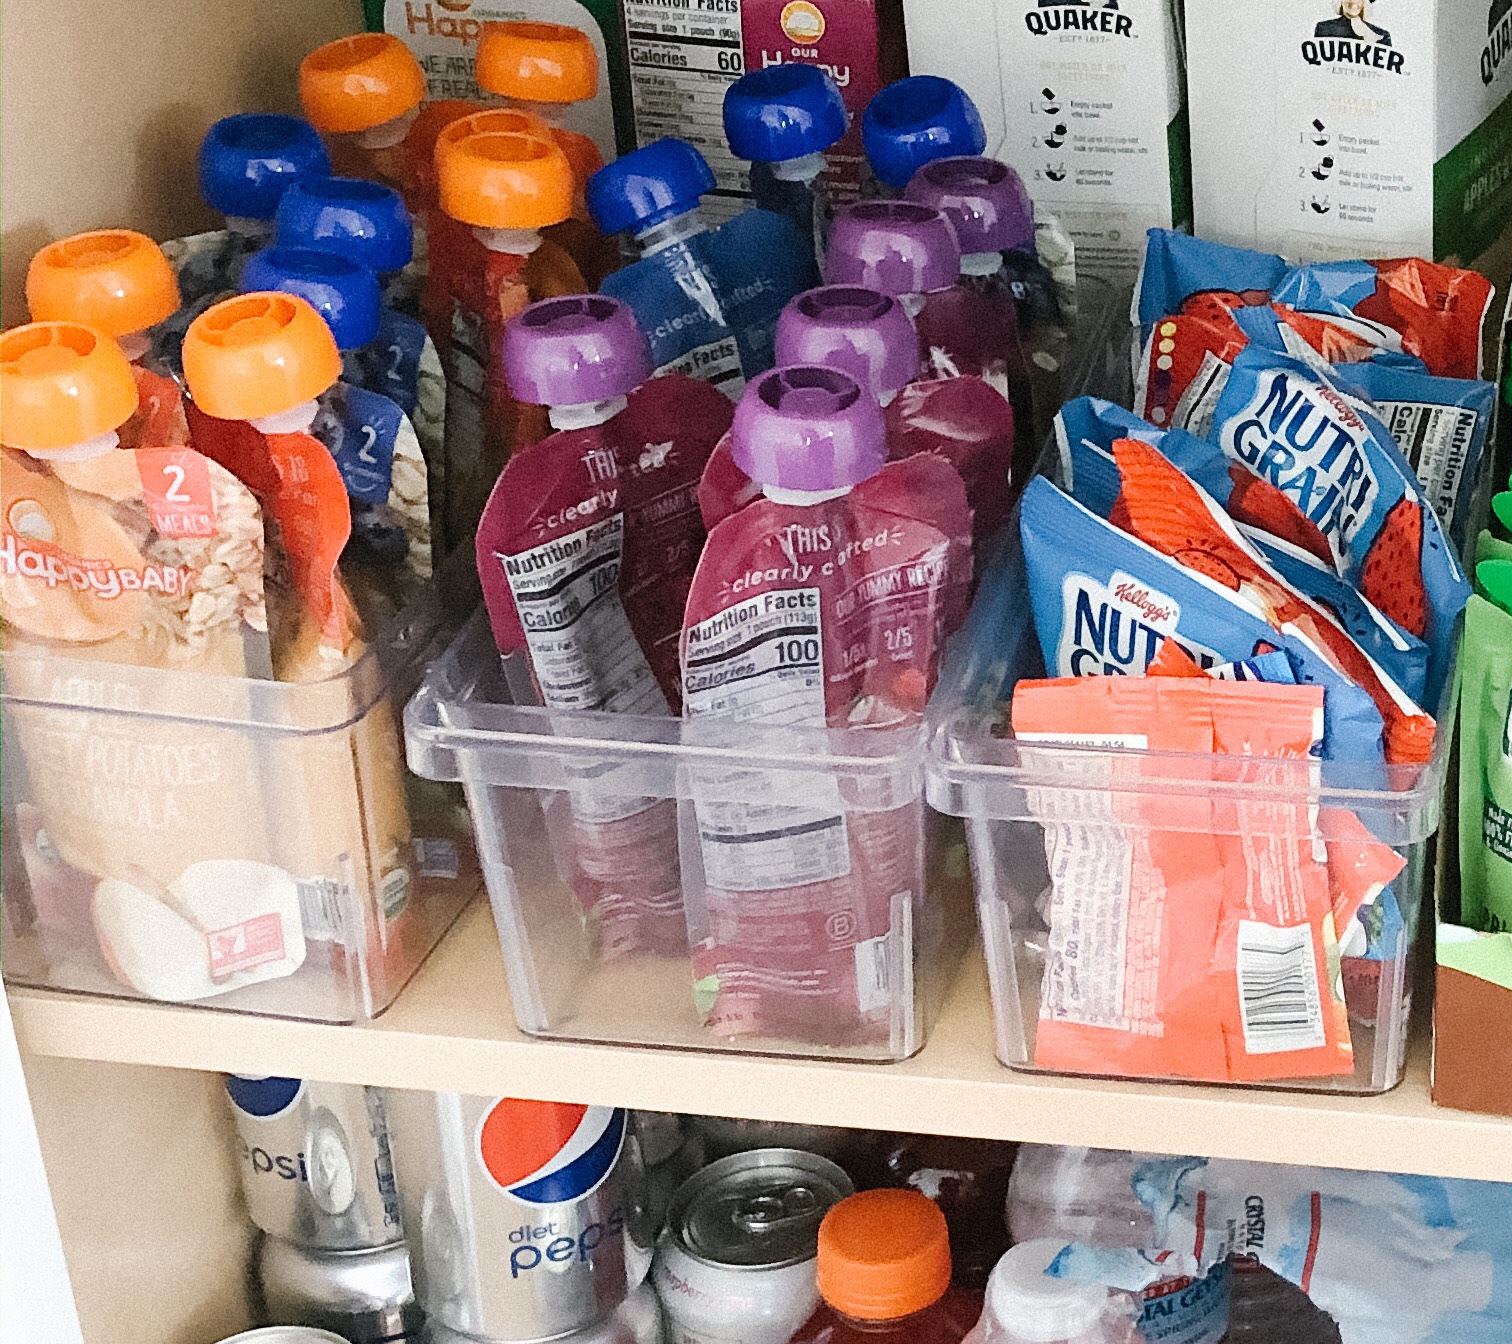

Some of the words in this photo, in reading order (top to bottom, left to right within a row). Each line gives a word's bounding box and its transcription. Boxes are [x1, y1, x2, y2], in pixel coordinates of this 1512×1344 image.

[1024, 9, 1134, 39] QUAKER
[630, 47, 688, 68] Calories
[717, 51, 744, 71] 60
[790, 47, 820, 59] OUR
[1300, 40, 1406, 76] QUAKER
[359, 425, 379, 464] 2
[1255, 372, 1373, 513] NUTRI
[1443, 411, 1475, 493] Nutrition
[162, 465, 191, 503] 2
[546, 487, 619, 529] clearly
[506, 538, 582, 577] Nutrition
[783, 523, 832, 554] THIS
[732, 563, 813, 594] clearly
[688, 602, 759, 644] Nutrition
[763, 592, 818, 614] Facts
[1114, 582, 1171, 623] Kellogg's
[684, 662, 767, 690] Calories
[775, 639, 820, 663] 100
[508, 1219, 558, 1245] diet
